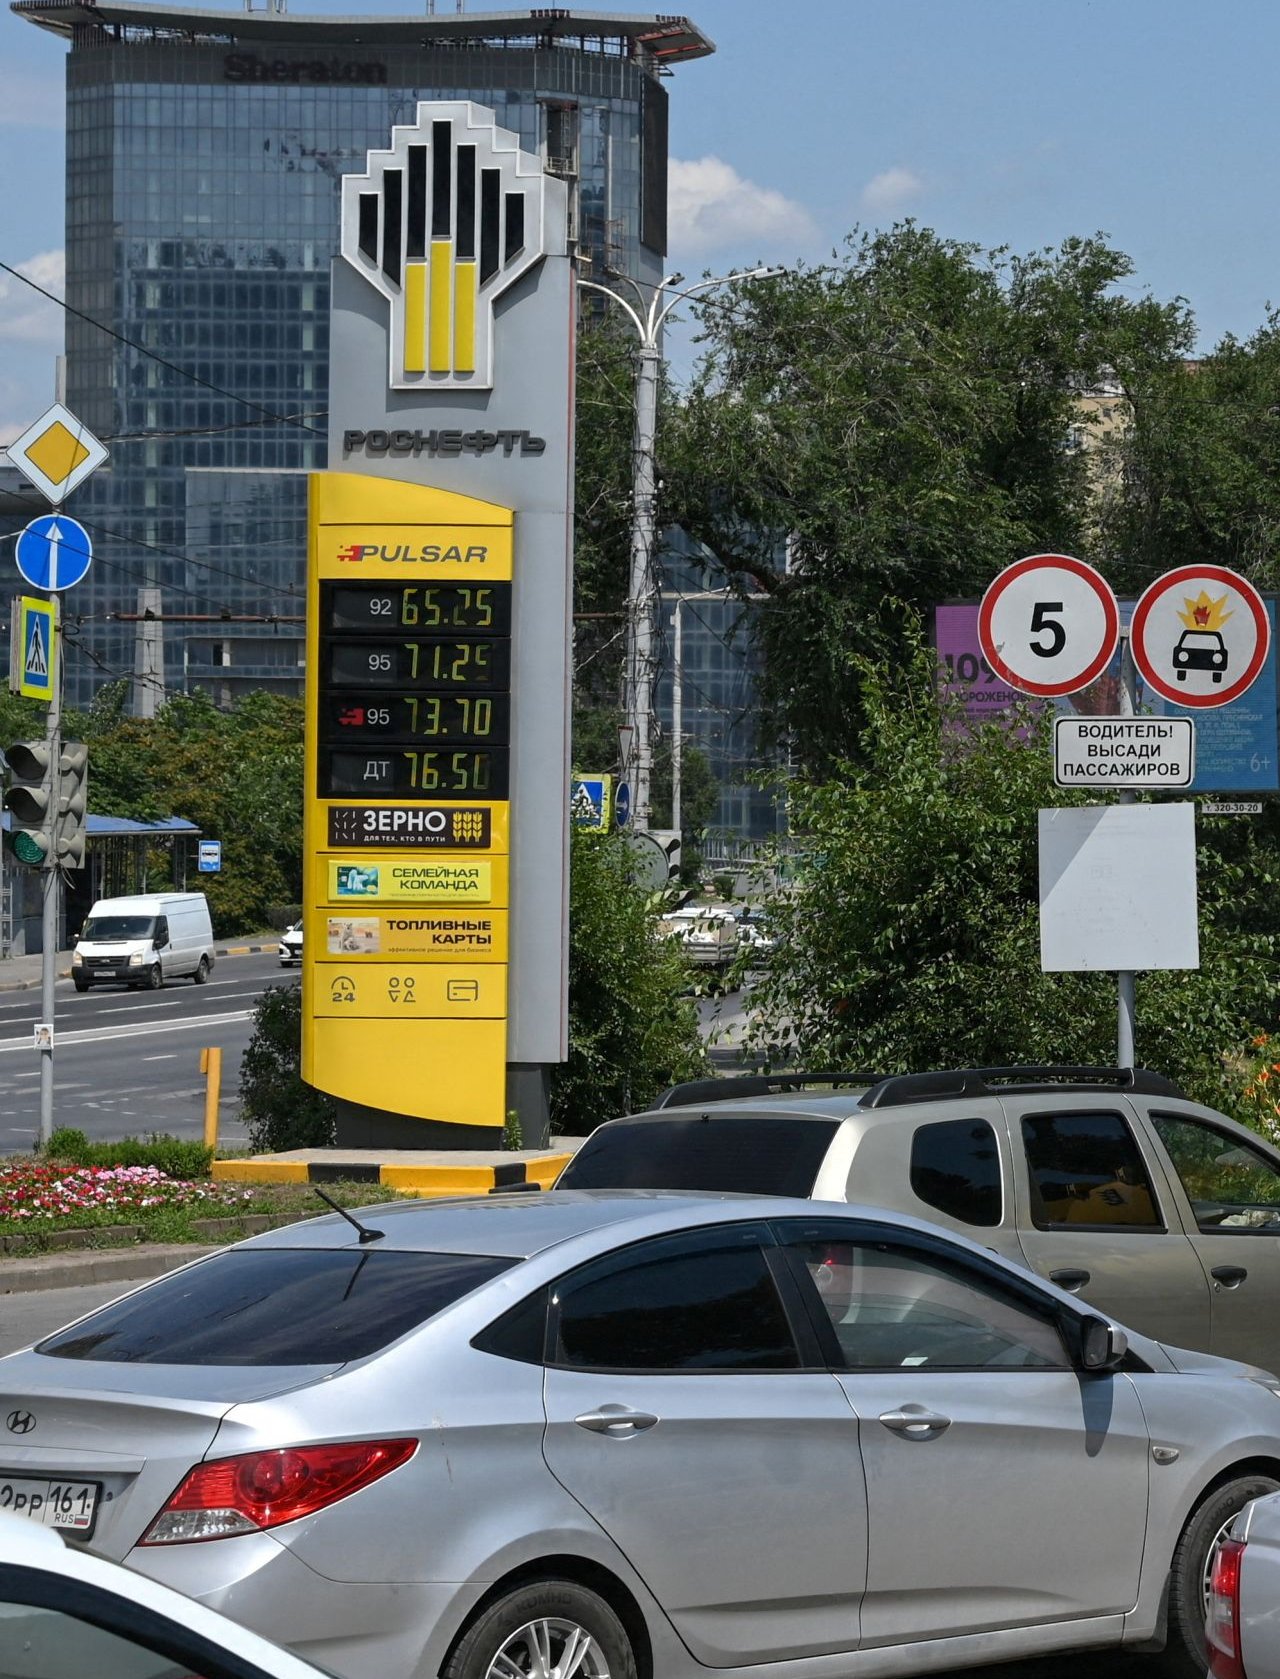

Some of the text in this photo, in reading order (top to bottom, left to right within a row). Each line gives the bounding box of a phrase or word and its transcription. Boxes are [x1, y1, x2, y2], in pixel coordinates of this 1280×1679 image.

[343, 429, 546, 452] РОСНЕФТЬ
[359, 545, 488, 562] PULSAR
[369, 598, 392, 615] 92
[1029, 601, 1066, 658] 5
[368, 654, 391, 671] 95
[366, 698, 492, 736] 95 73.70
[1078, 724, 1173, 740] ВОДИТЕЛЬ!
[1087, 744, 1161, 759] ВЫСАДИ
[1063, 762, 1180, 777] ПАССАЖИРОВ
[1250, 752, 1271, 772] 6+
[363, 752, 491, 790] ДТ 76.50
[1214, 803, 1258, 812] 320-30-20
[363, 810, 447, 832] ЗЕРНО
[392, 866, 479, 878] СЕМЕЙНАЯ
[400, 880, 479, 891] КОМАНДА
[386, 920, 492, 931] ТОПЛИВНЫЕ
[432, 934, 492, 944] КАРТЫ
[332, 992, 356, 1002] 24
[50, 1486, 89, 1515] 161
[54, 1512, 74, 1524] RUS
